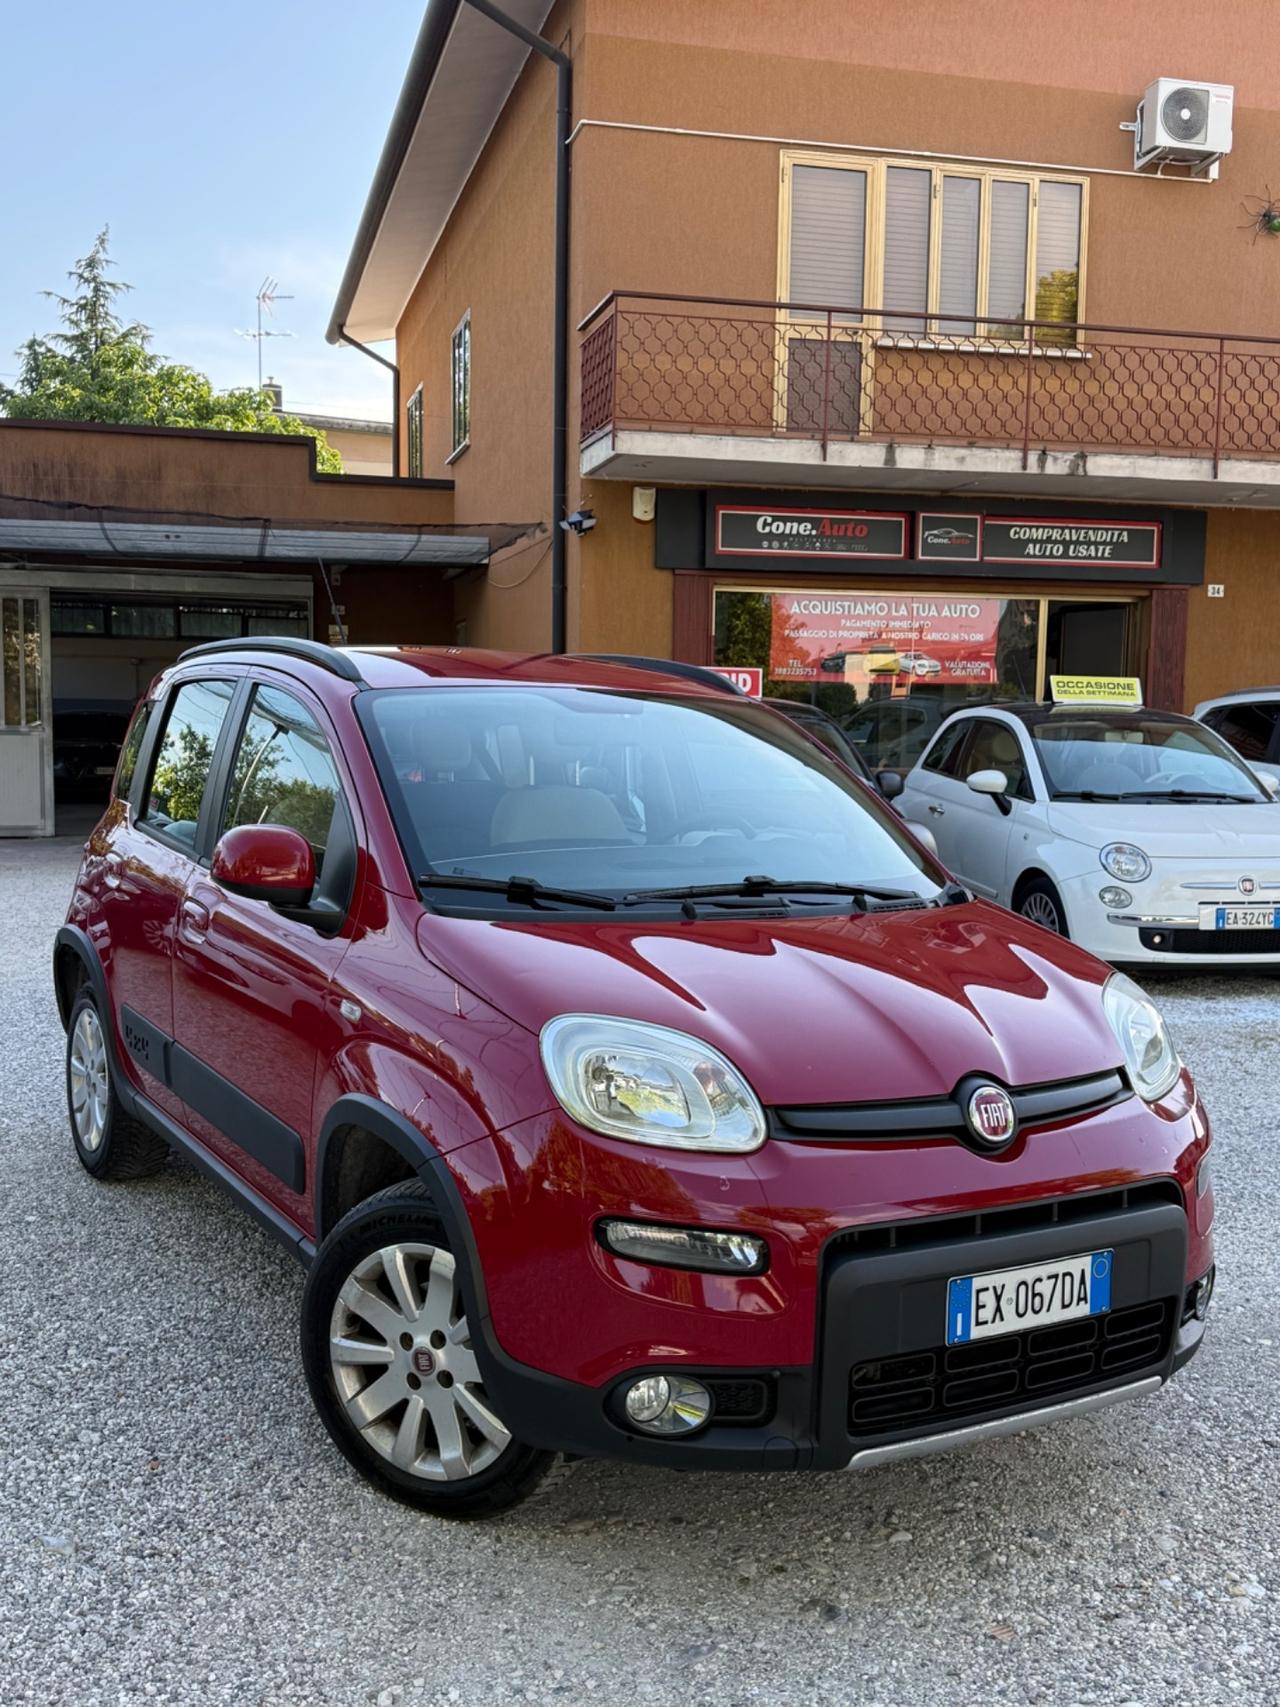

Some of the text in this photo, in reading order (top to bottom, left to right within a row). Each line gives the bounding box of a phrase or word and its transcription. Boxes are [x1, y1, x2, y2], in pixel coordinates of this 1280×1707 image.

[756, 516, 869, 537] Cone.Auto
[1009, 527, 1128, 542] COMPRAVENDITA
[1024, 543, 1113, 557] AUTO USATE
[791, 600, 980, 618] ACQUISTIAMO LA TUA AUTO
[784, 629, 827, 638] PASSAGGIO
[1056, 680, 1135, 690] OCCASIONE
[980, 1103, 1006, 1128] FIAT
[974, 1283, 1006, 1327] EX
[1014, 1268, 1089, 1319] 067DA
